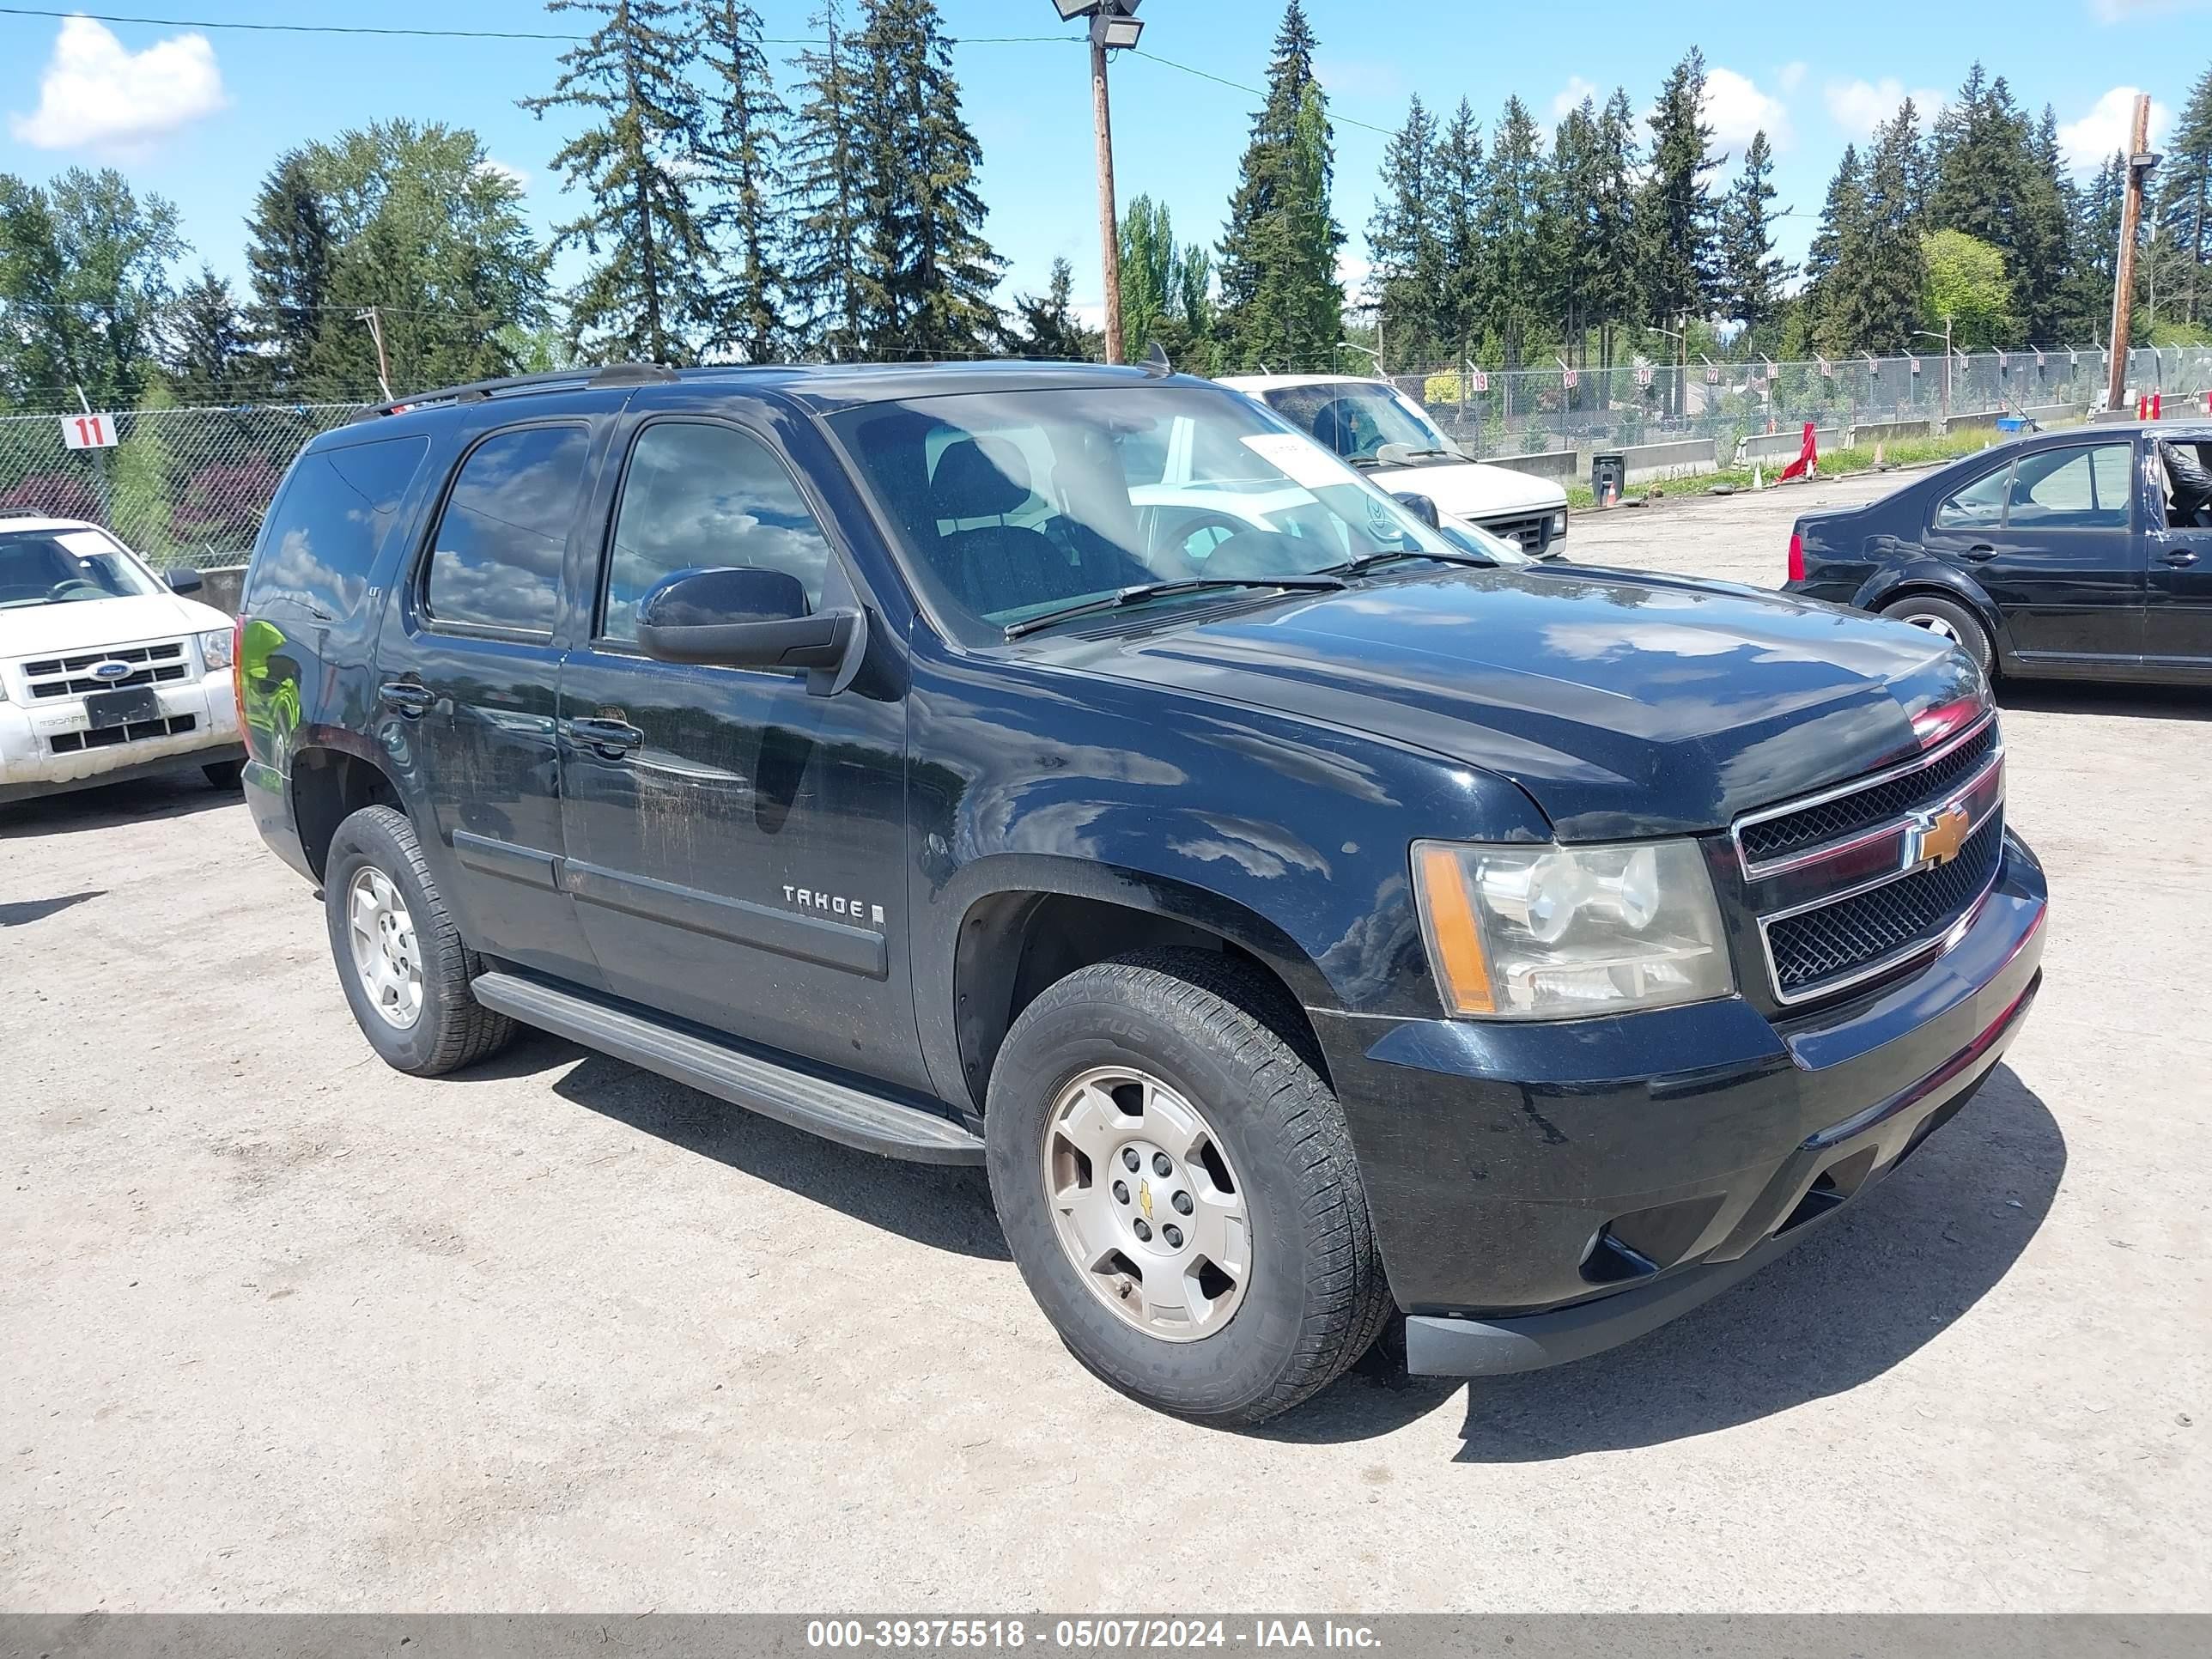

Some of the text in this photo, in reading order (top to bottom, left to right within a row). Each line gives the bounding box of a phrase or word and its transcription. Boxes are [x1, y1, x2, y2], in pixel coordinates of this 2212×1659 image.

[1768, 364, 1778, 378] 23
[1822, 363, 1831, 376] 24
[1912, 361, 1919, 373] 26
[1474, 374, 1486, 390] 19
[1565, 371, 1577, 387] 20
[1640, 369, 1650, 383] 21
[1708, 369, 1717, 382] 22
[76, 417, 104, 446] 11
[40, 714, 88, 727] ESCAPE
[782, 885, 864, 918] TAHOE
